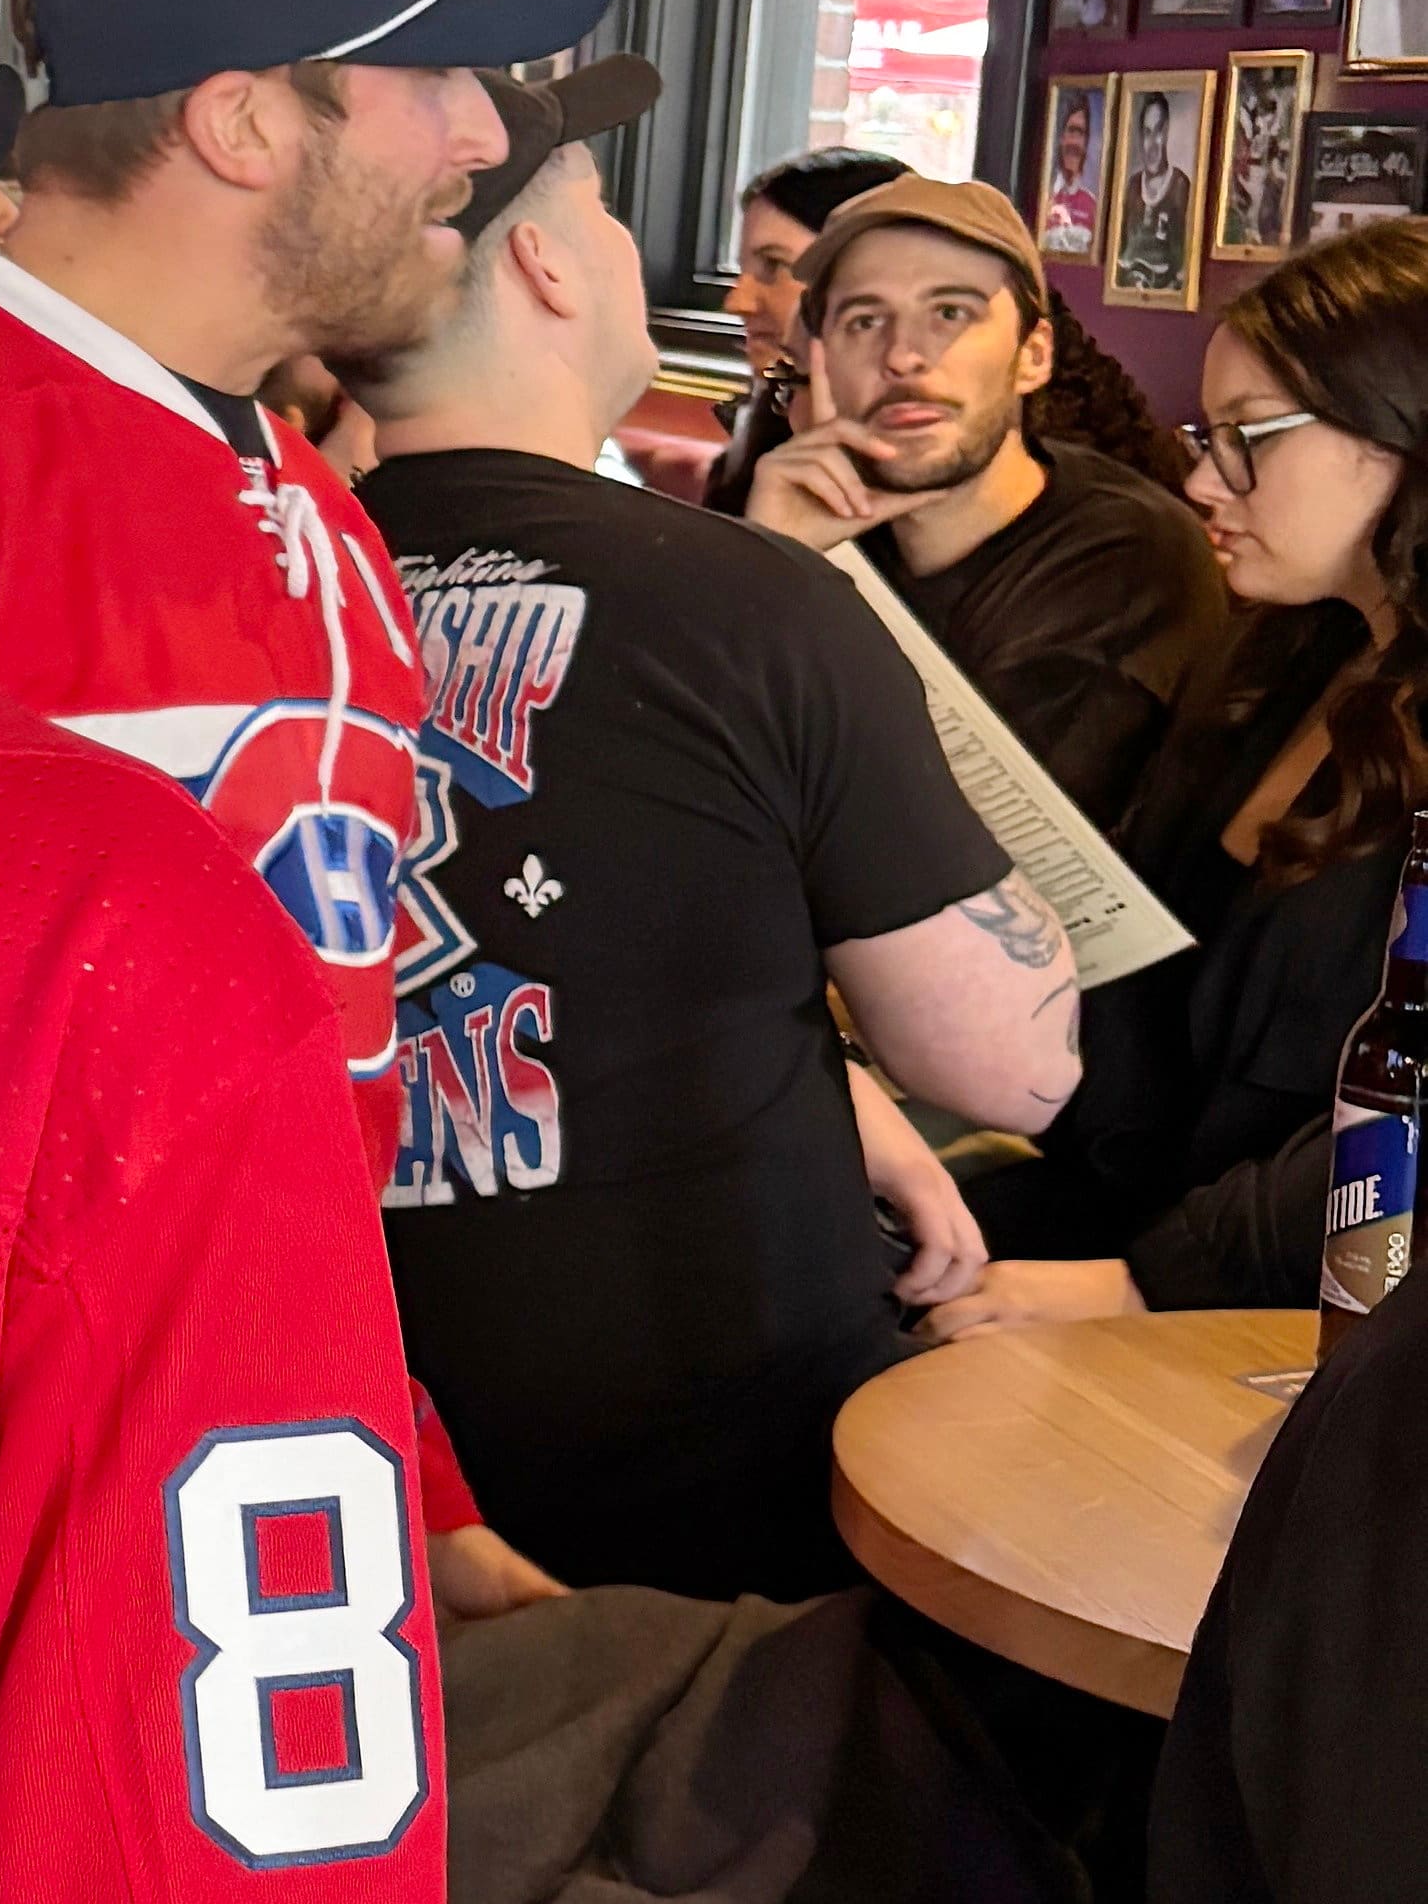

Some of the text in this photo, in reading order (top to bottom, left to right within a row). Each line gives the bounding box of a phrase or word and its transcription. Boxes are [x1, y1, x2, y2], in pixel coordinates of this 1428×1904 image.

[412, 582, 586, 796] SHIP
[1326, 1174, 1385, 1237] TIDE
[163, 1416, 430, 1870] 8
